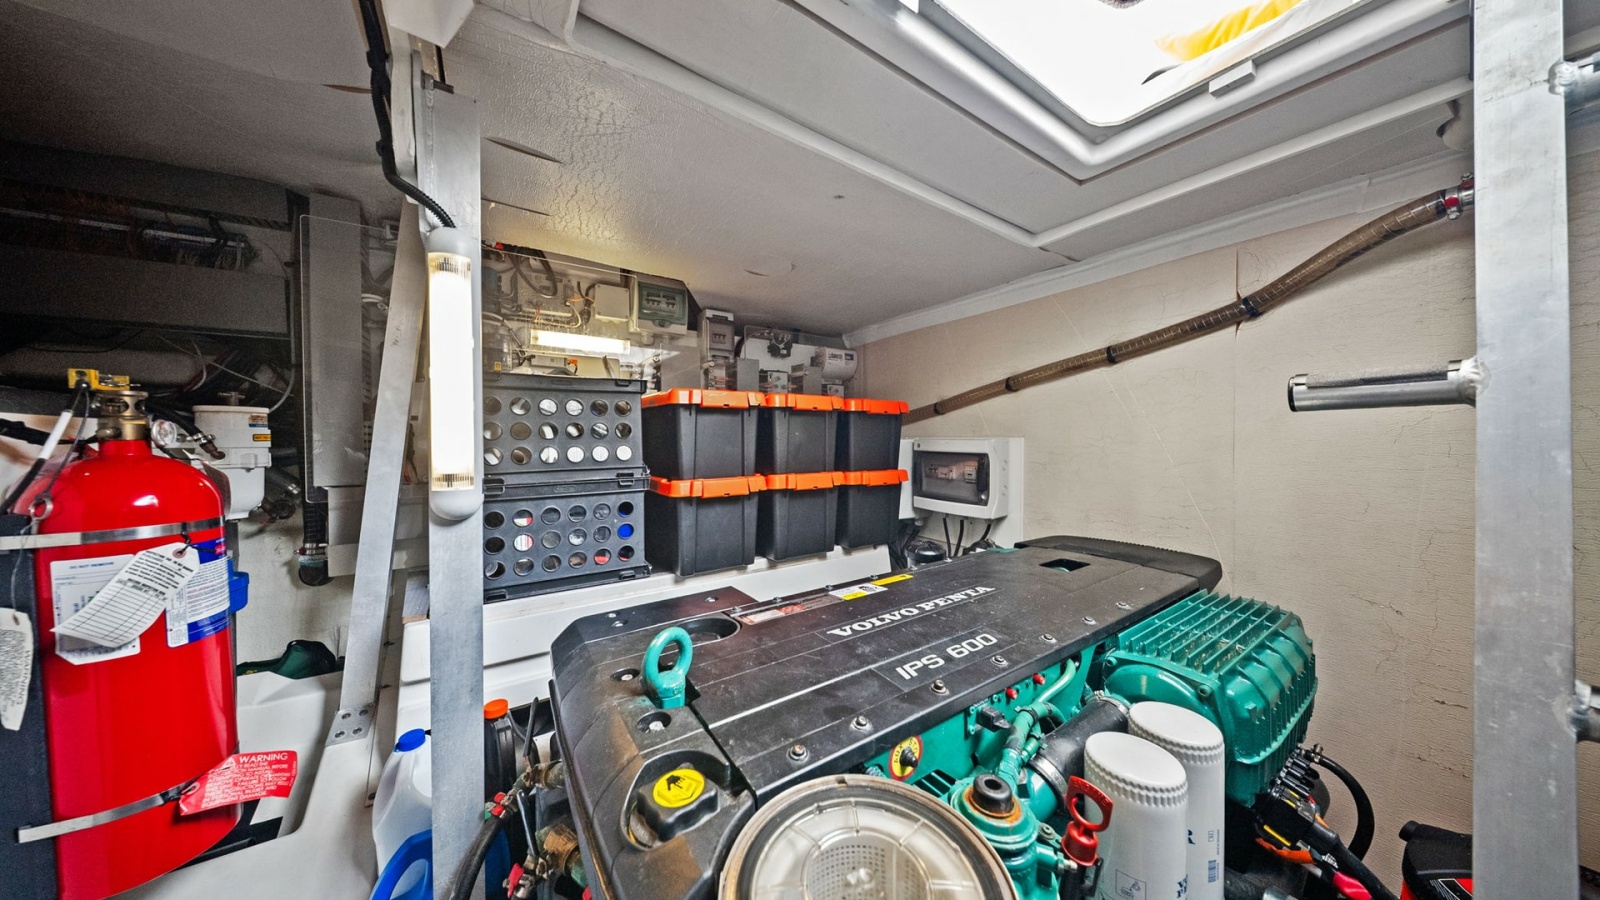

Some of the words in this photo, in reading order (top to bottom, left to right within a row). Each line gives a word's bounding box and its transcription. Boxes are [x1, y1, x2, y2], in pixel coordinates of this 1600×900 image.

[826, 607, 919, 637] VOLVO
[916, 586, 995, 611] PENTA
[895, 654, 945, 680] IPS
[945, 633, 998, 659] 600
[239, 752, 289, 764] WARNING
